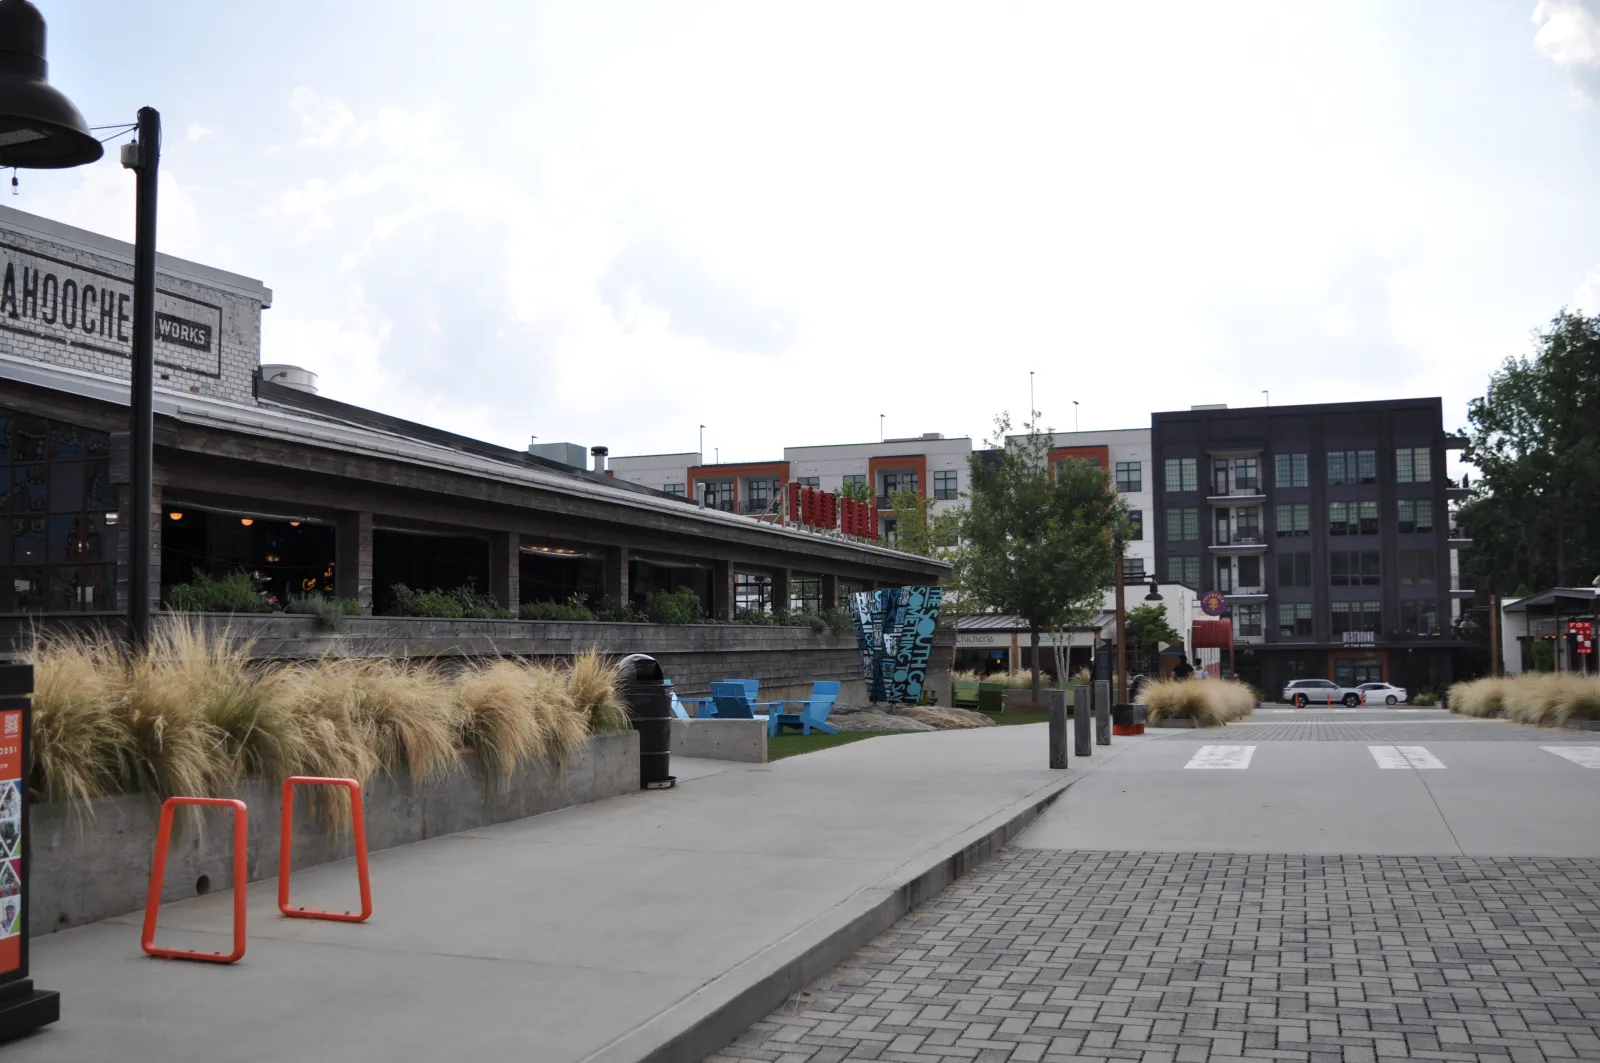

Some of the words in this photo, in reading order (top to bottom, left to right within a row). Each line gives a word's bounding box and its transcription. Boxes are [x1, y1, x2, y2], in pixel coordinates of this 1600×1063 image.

[158, 318, 206, 345] WORKS
[928, 586, 943, 607] THE
[898, 586, 926, 663] SOMETHING
[910, 609, 938, 668] SOUTH
[893, 663, 910, 682] TO
[889, 684, 906, 702] SAY
[905, 670, 925, 704] GOT
